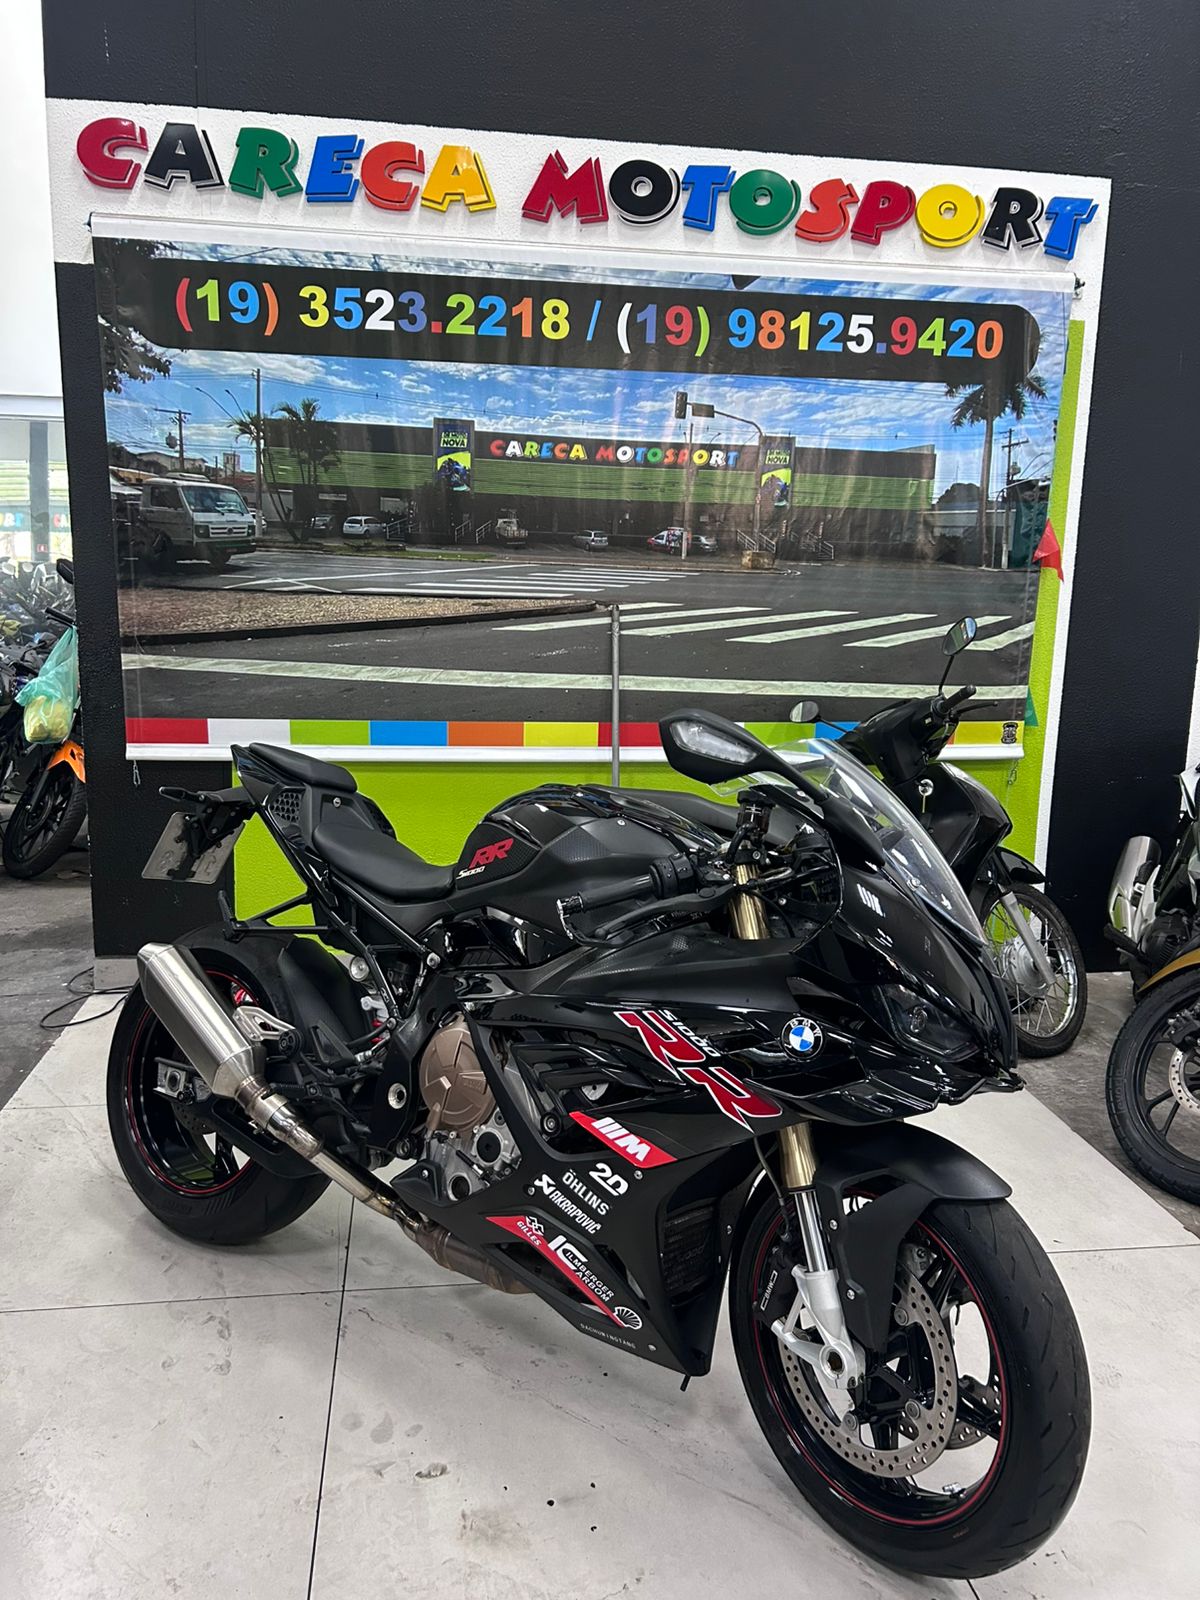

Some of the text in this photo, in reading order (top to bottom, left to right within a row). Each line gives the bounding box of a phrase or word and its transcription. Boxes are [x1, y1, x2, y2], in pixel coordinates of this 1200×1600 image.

[76, 116, 1098, 261] CARECA MOTOSPORT
[175, 277, 279, 336] (19)
[299, 285, 571, 340] 3523.2218
[616, 302, 710, 357] (19)
[727, 309, 1004, 359] 98125.9420
[442, 439, 467, 447] NOVA
[489, 439, 741, 468] CARECA MOTOSPORT
[469, 837, 515, 870] RR
[658, 1009, 721, 1058] S1000
[562, 1168, 610, 1216] ÖHLINS
[516, 1220, 542, 1246] GILLES
